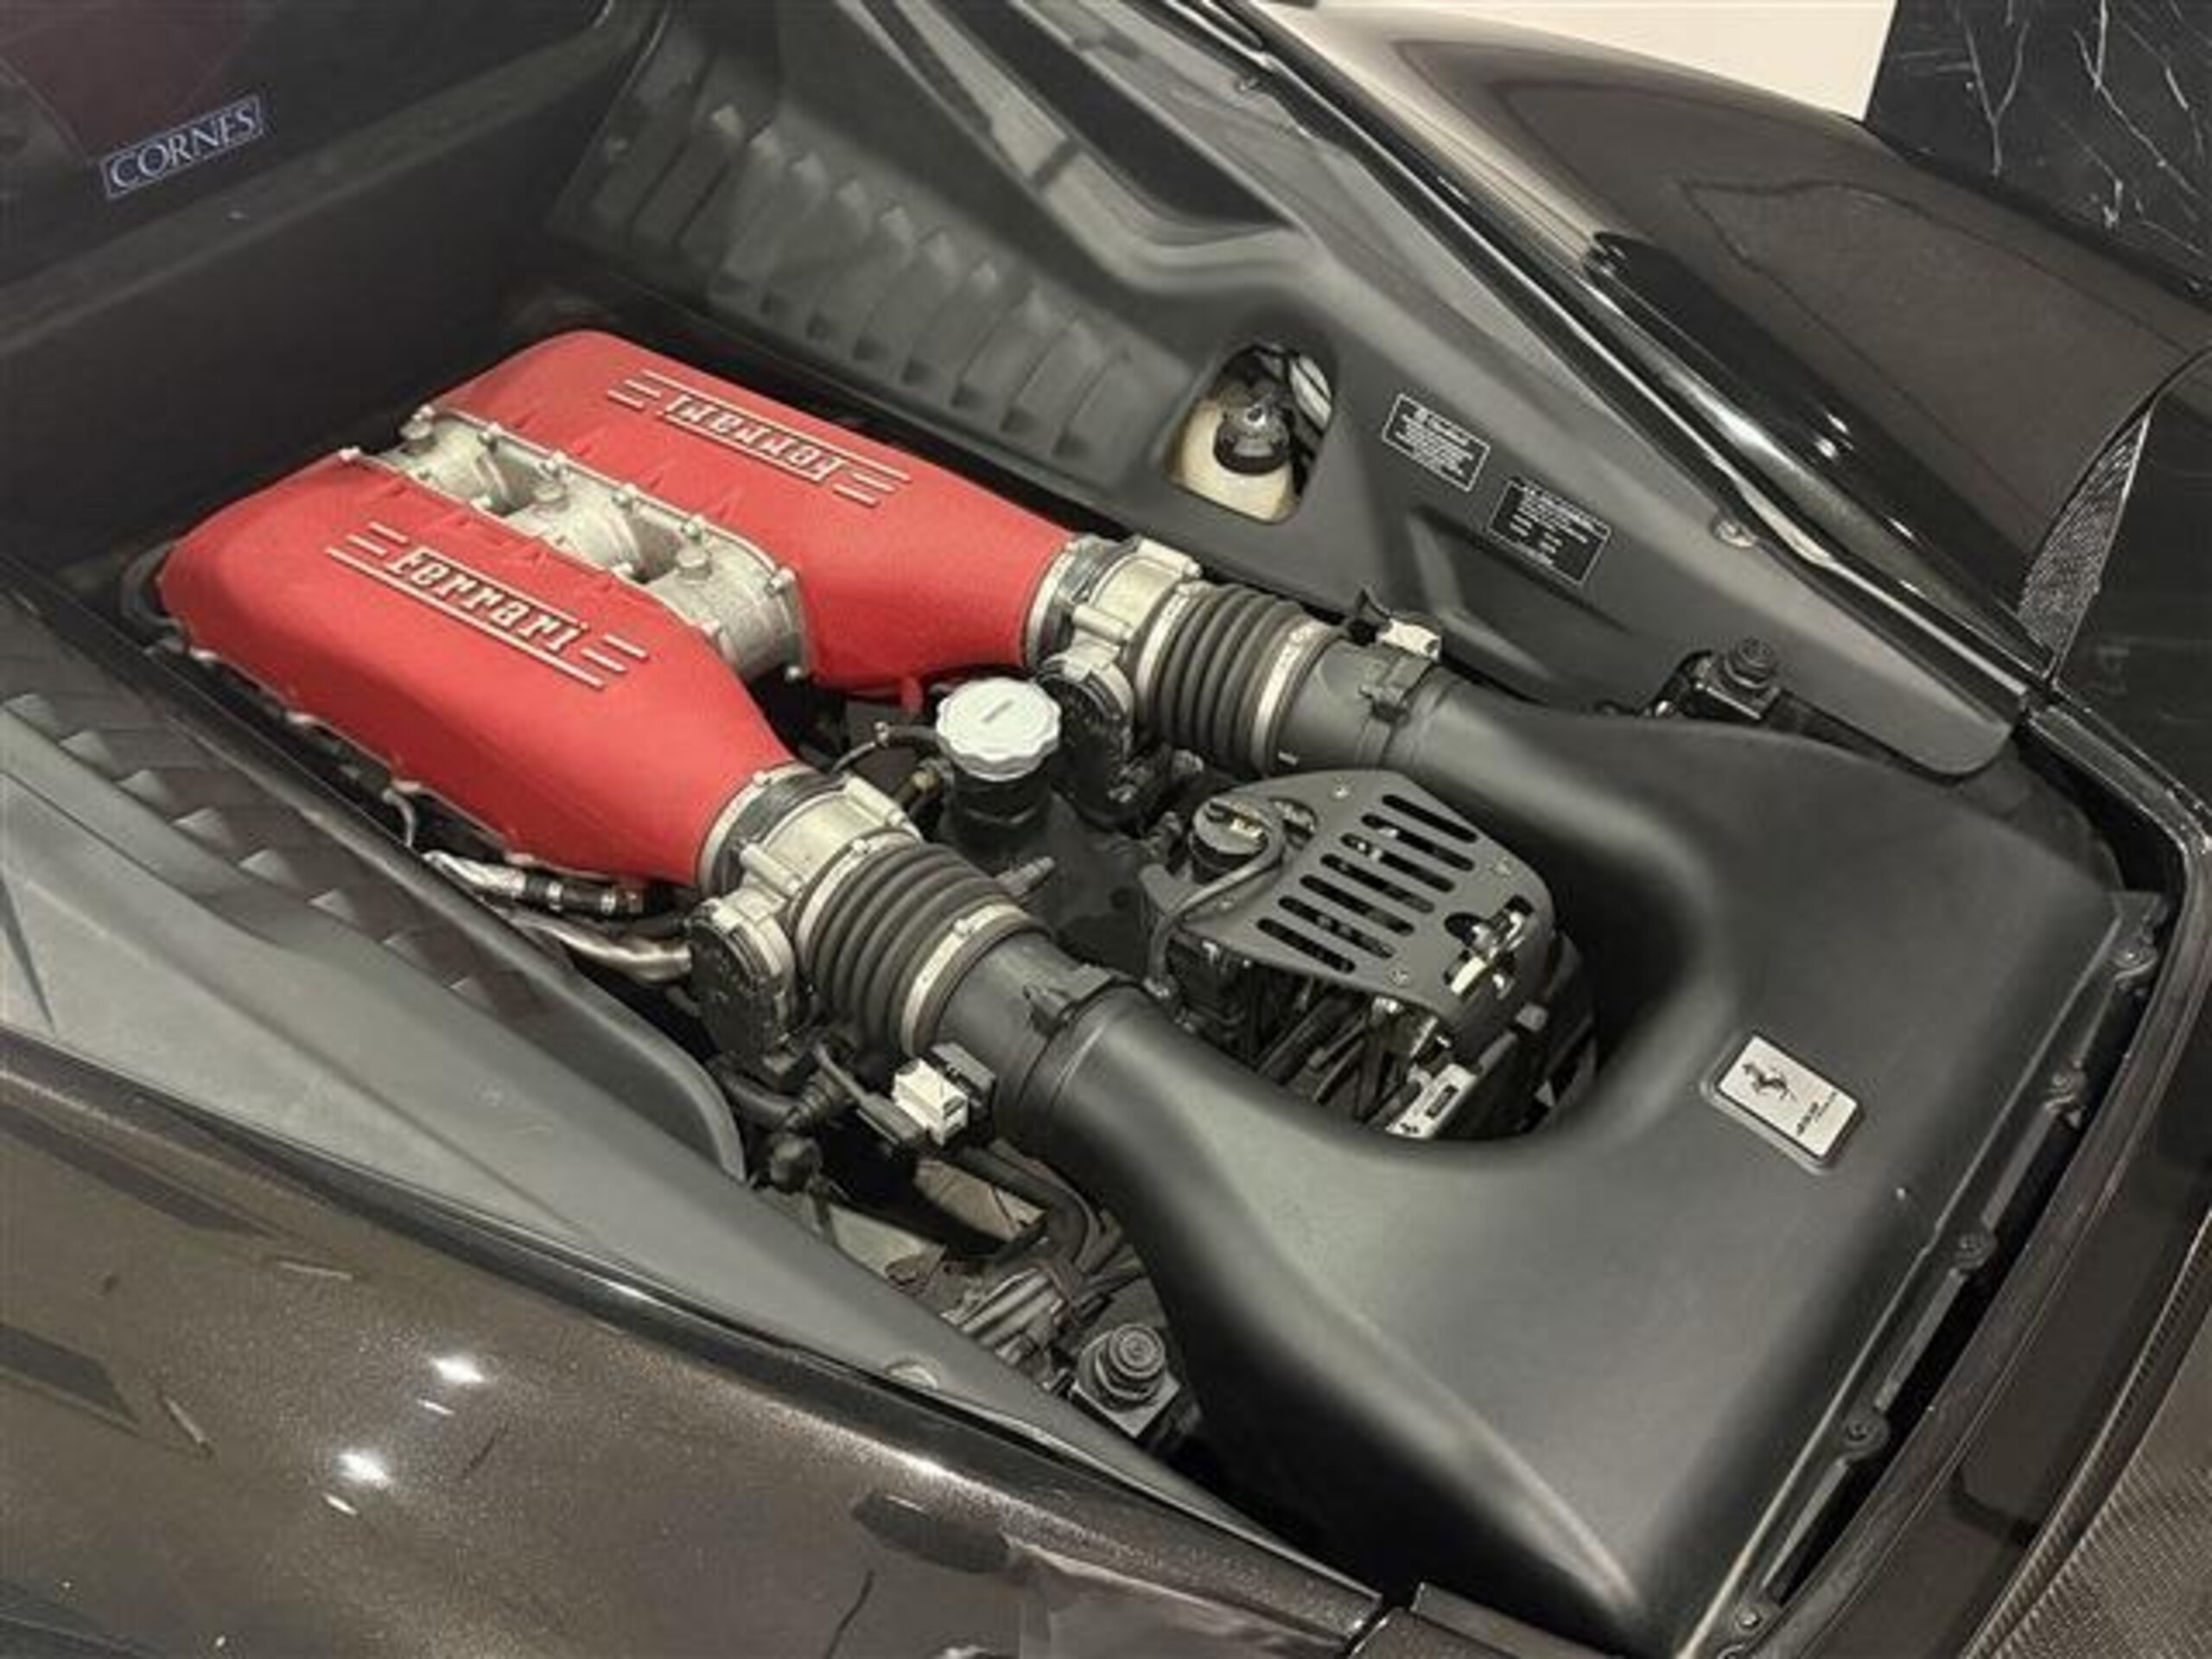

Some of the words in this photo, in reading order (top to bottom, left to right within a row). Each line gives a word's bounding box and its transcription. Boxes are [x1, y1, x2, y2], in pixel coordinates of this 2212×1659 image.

[111, 105, 256, 188] CORNES
[658, 393, 848, 482] Ferrari
[384, 545, 590, 651] Ferrari
